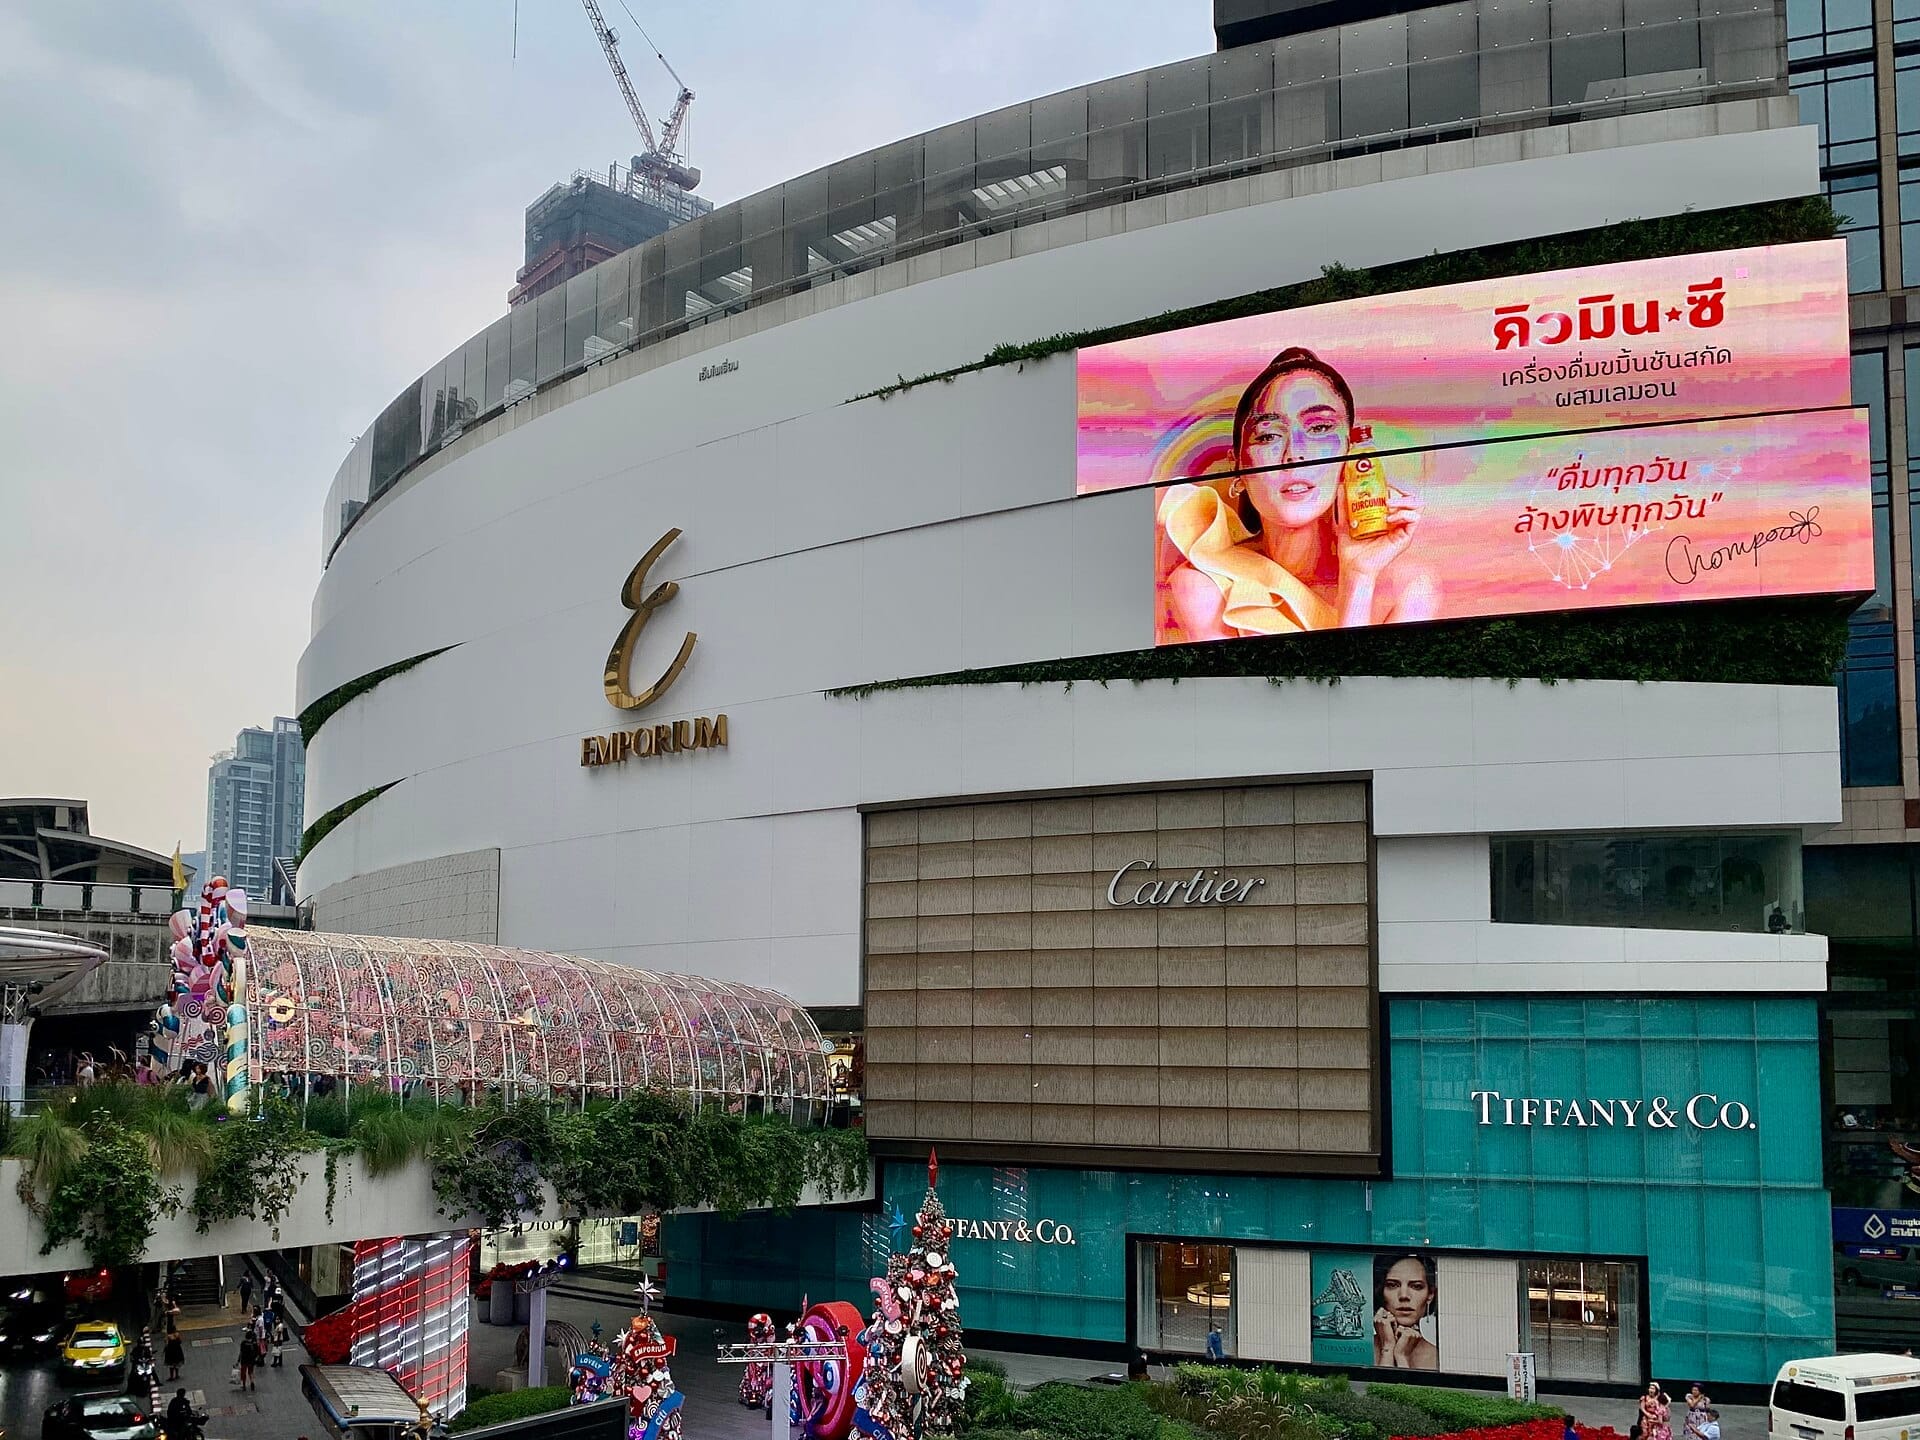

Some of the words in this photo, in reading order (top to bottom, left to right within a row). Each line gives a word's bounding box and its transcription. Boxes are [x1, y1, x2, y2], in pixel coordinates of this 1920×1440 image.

[1502, 345, 1732, 387] เครื่องดื่มขมิ้นชันสกัด
[1555, 380, 1677, 407] ผสมเลมอน
[1351, 497, 1387, 513] CURCUMIN
[580, 713, 729, 768] EMPORIUM
[1106, 858, 1266, 906] Cartier
[1470, 1090, 1644, 1127] TIFFANY
[1646, 1095, 1680, 1129] &
[1014, 1218, 1033, 1243] &
[579, 1357, 602, 1370] LOVELY
[634, 1343, 667, 1357] EMPORIUM
